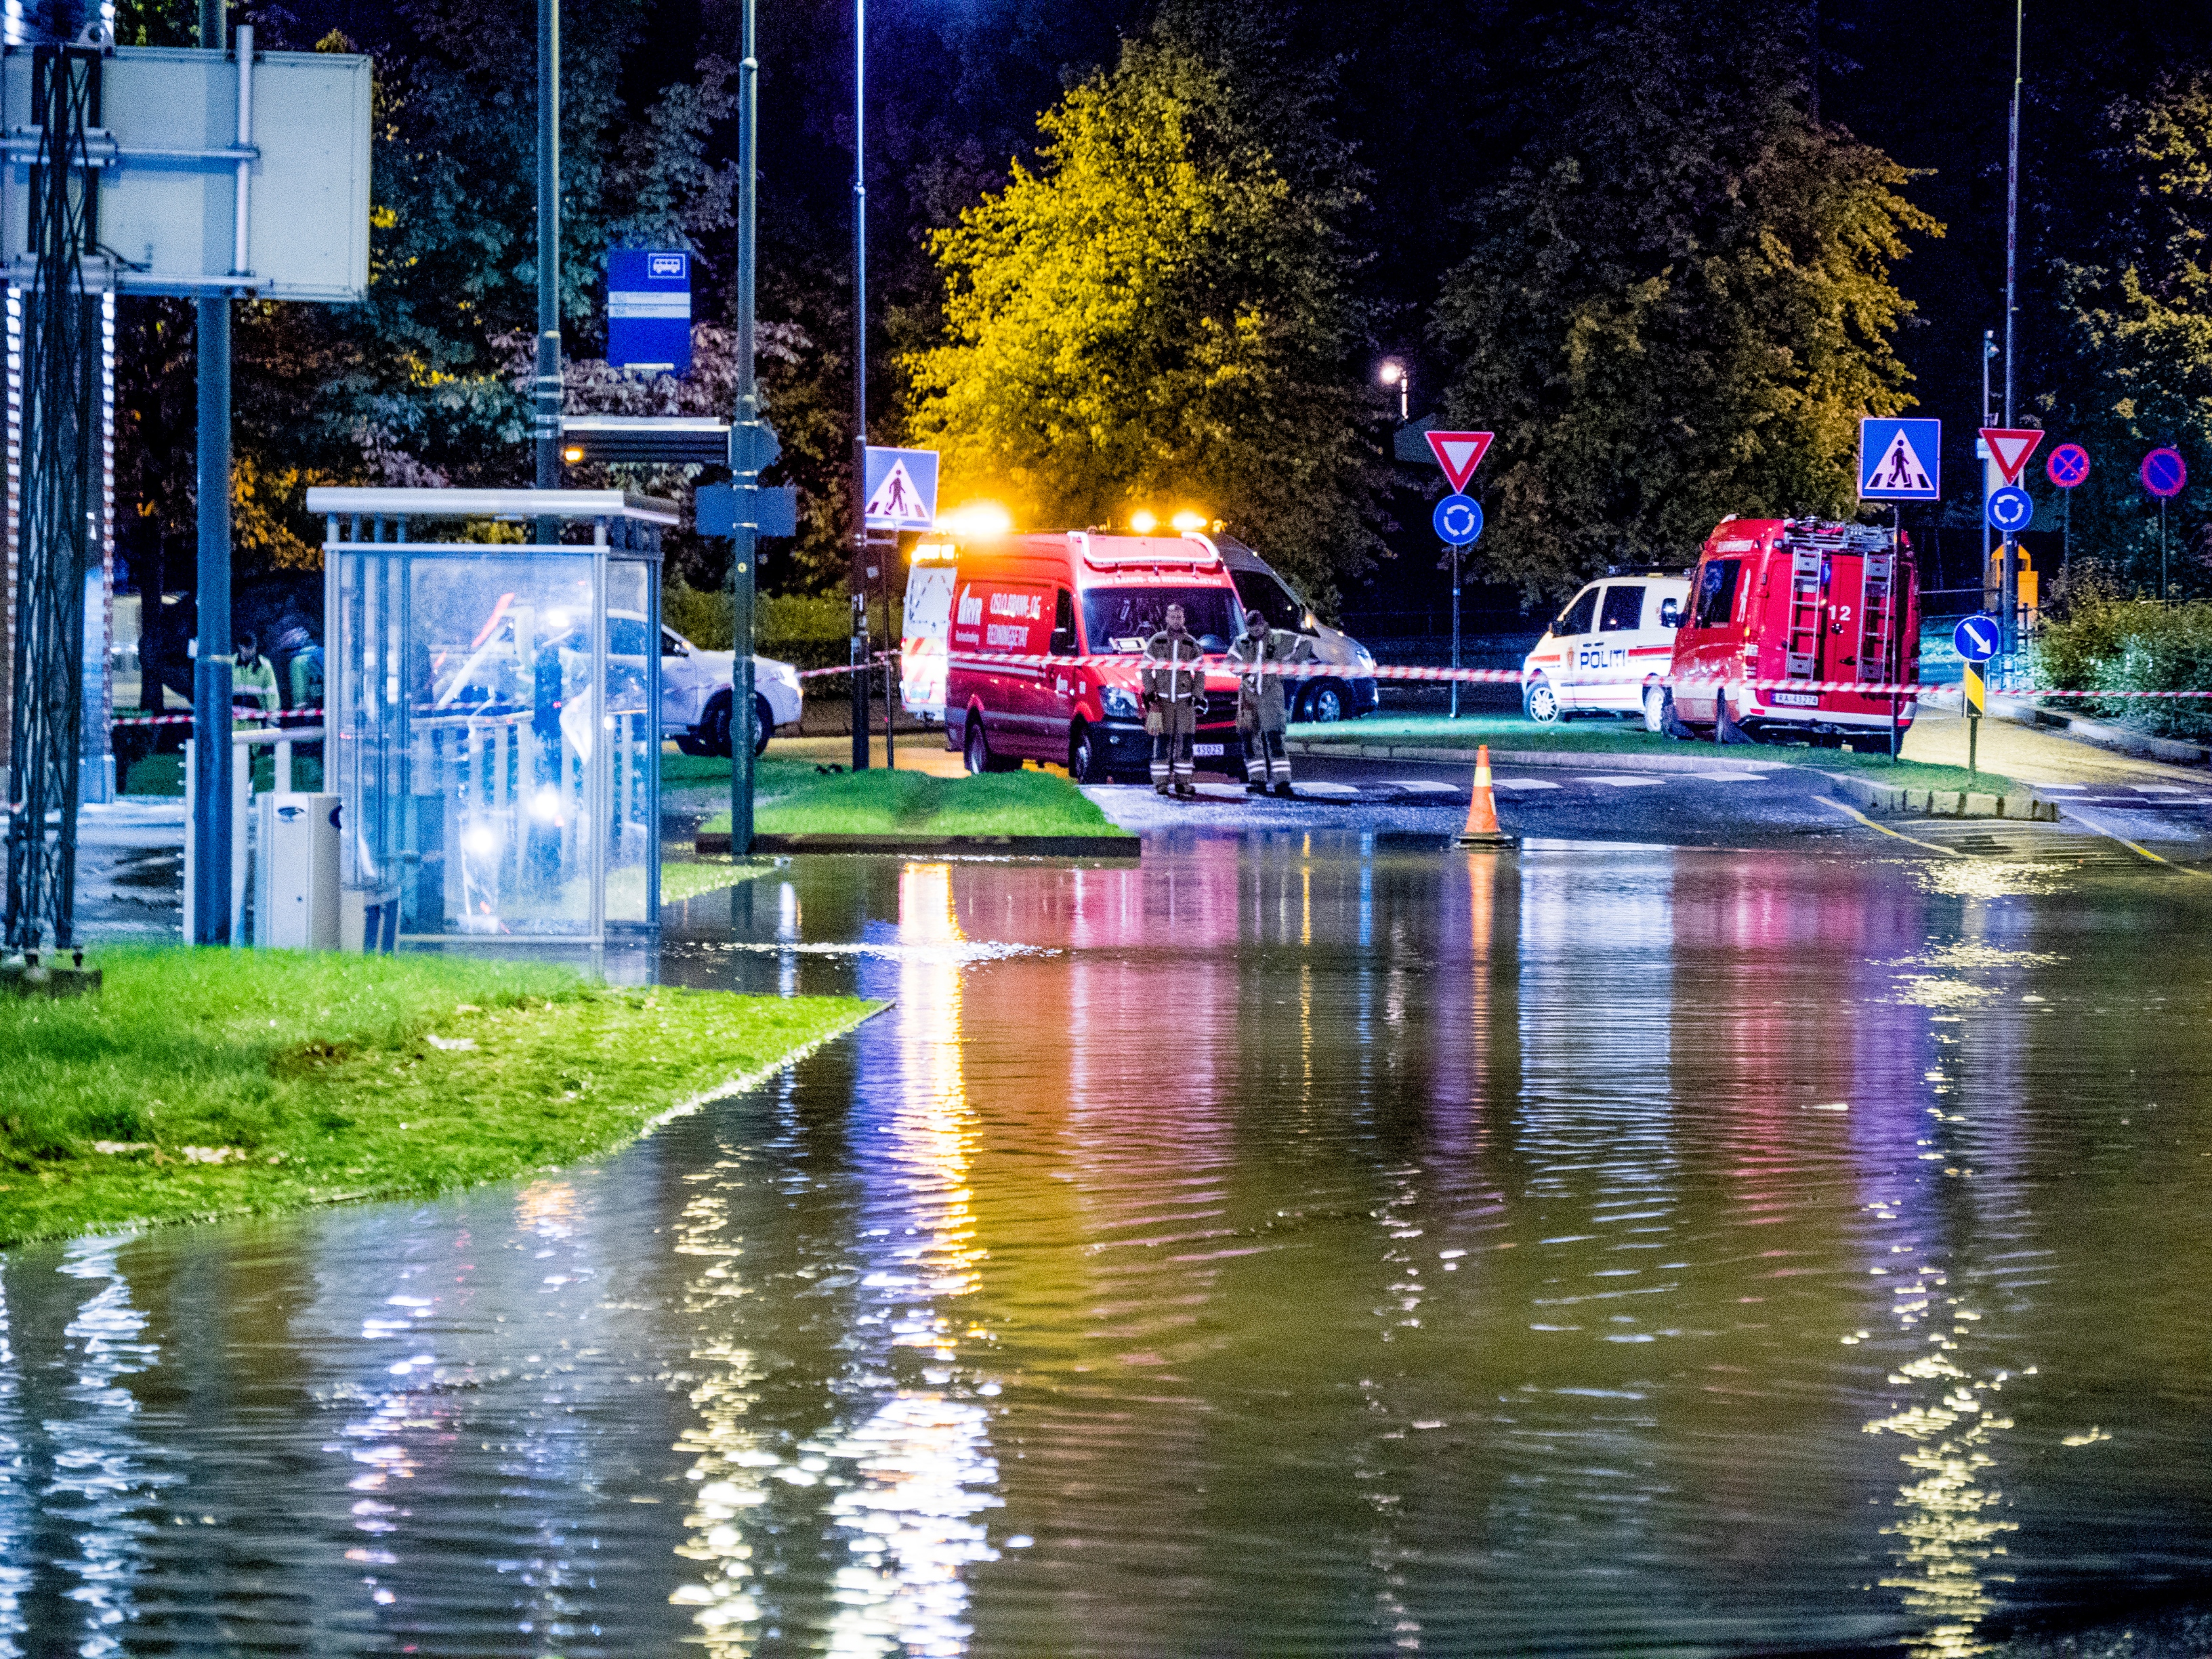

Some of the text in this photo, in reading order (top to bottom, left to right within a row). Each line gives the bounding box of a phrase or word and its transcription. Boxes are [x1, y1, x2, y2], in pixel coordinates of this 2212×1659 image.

[990, 593, 1008, 615] OSLO
[1030, 595, 1041, 619] OG
[1828, 605, 1851, 621] 12
[986, 623, 1029, 647] REDNINGSETAT
[1580, 649, 1625, 670] POLITI
[1793, 696, 1817, 704] 43274
